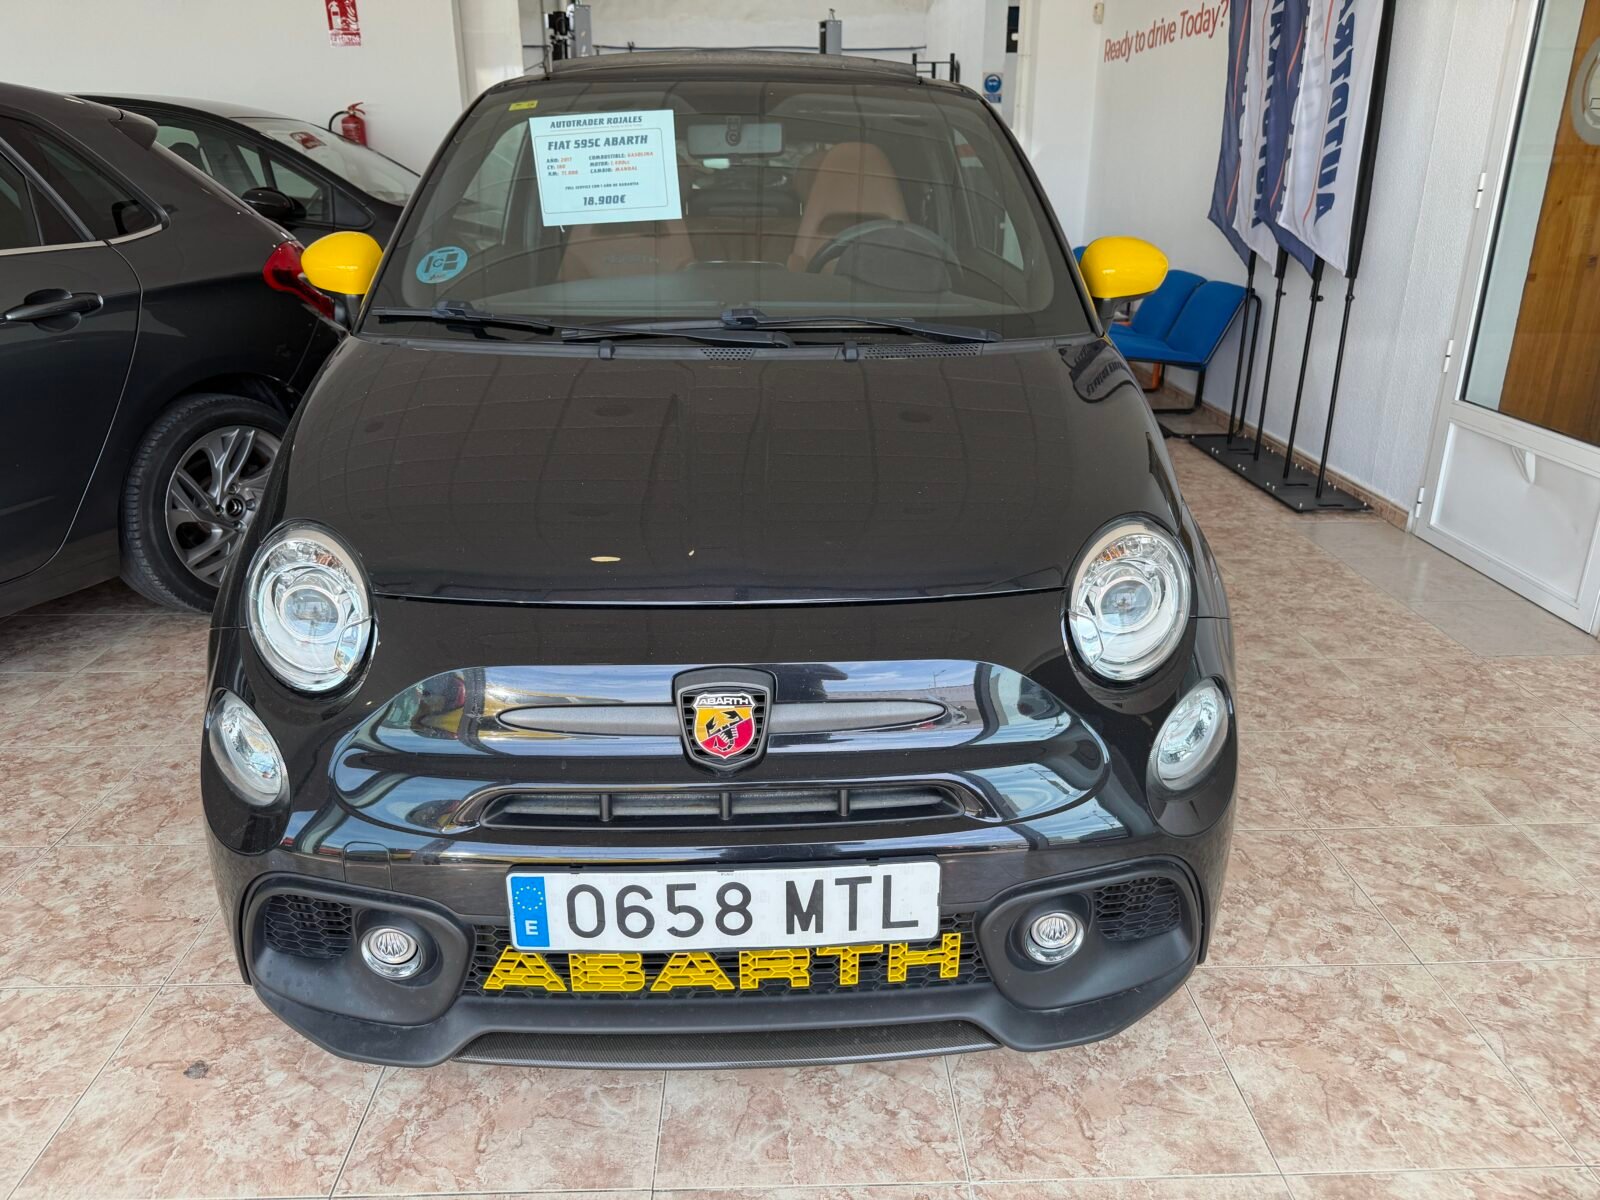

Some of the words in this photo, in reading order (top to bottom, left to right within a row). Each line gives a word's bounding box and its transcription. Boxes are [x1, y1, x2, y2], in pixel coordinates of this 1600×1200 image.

[1104, 30, 1133, 63] Ready
[1135, 30, 1145, 53] to
[1147, 17, 1176, 49] drive
[1180, 0, 1230, 40] Today?
[550, 117, 605, 129] AUTOTRADER
[607, 115, 643, 125] ROJALES
[547, 140, 571, 151] FIAT
[573, 138, 601, 149] 595C
[603, 134, 648, 147] ABARTH
[588, 152, 626, 160] COMBUSTIBLE:
[583, 194, 627, 206] 18.900€
[699, 696, 749, 705] ABARTH
[524, 919, 539, 937] E
[566, 881, 754, 939] 0658
[785, 874, 920, 935] MTL
[483, 932, 962, 993] ABARTH
